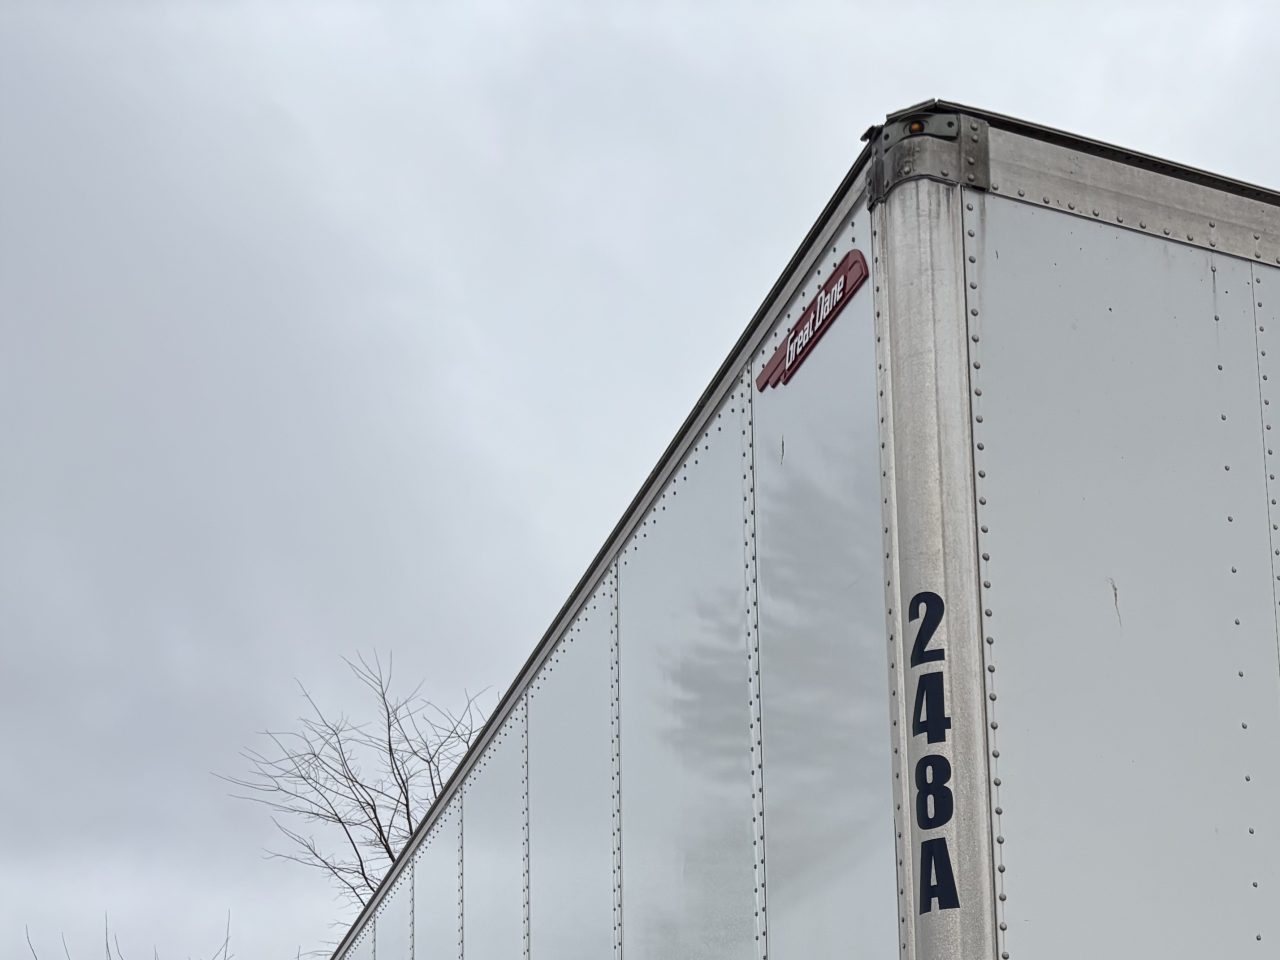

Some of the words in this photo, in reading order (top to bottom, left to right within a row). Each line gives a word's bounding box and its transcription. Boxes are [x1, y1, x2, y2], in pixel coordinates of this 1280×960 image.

[785, 311, 815, 371] Great
[814, 274, 845, 331] Dane
[908, 591, 961, 916] 248A
